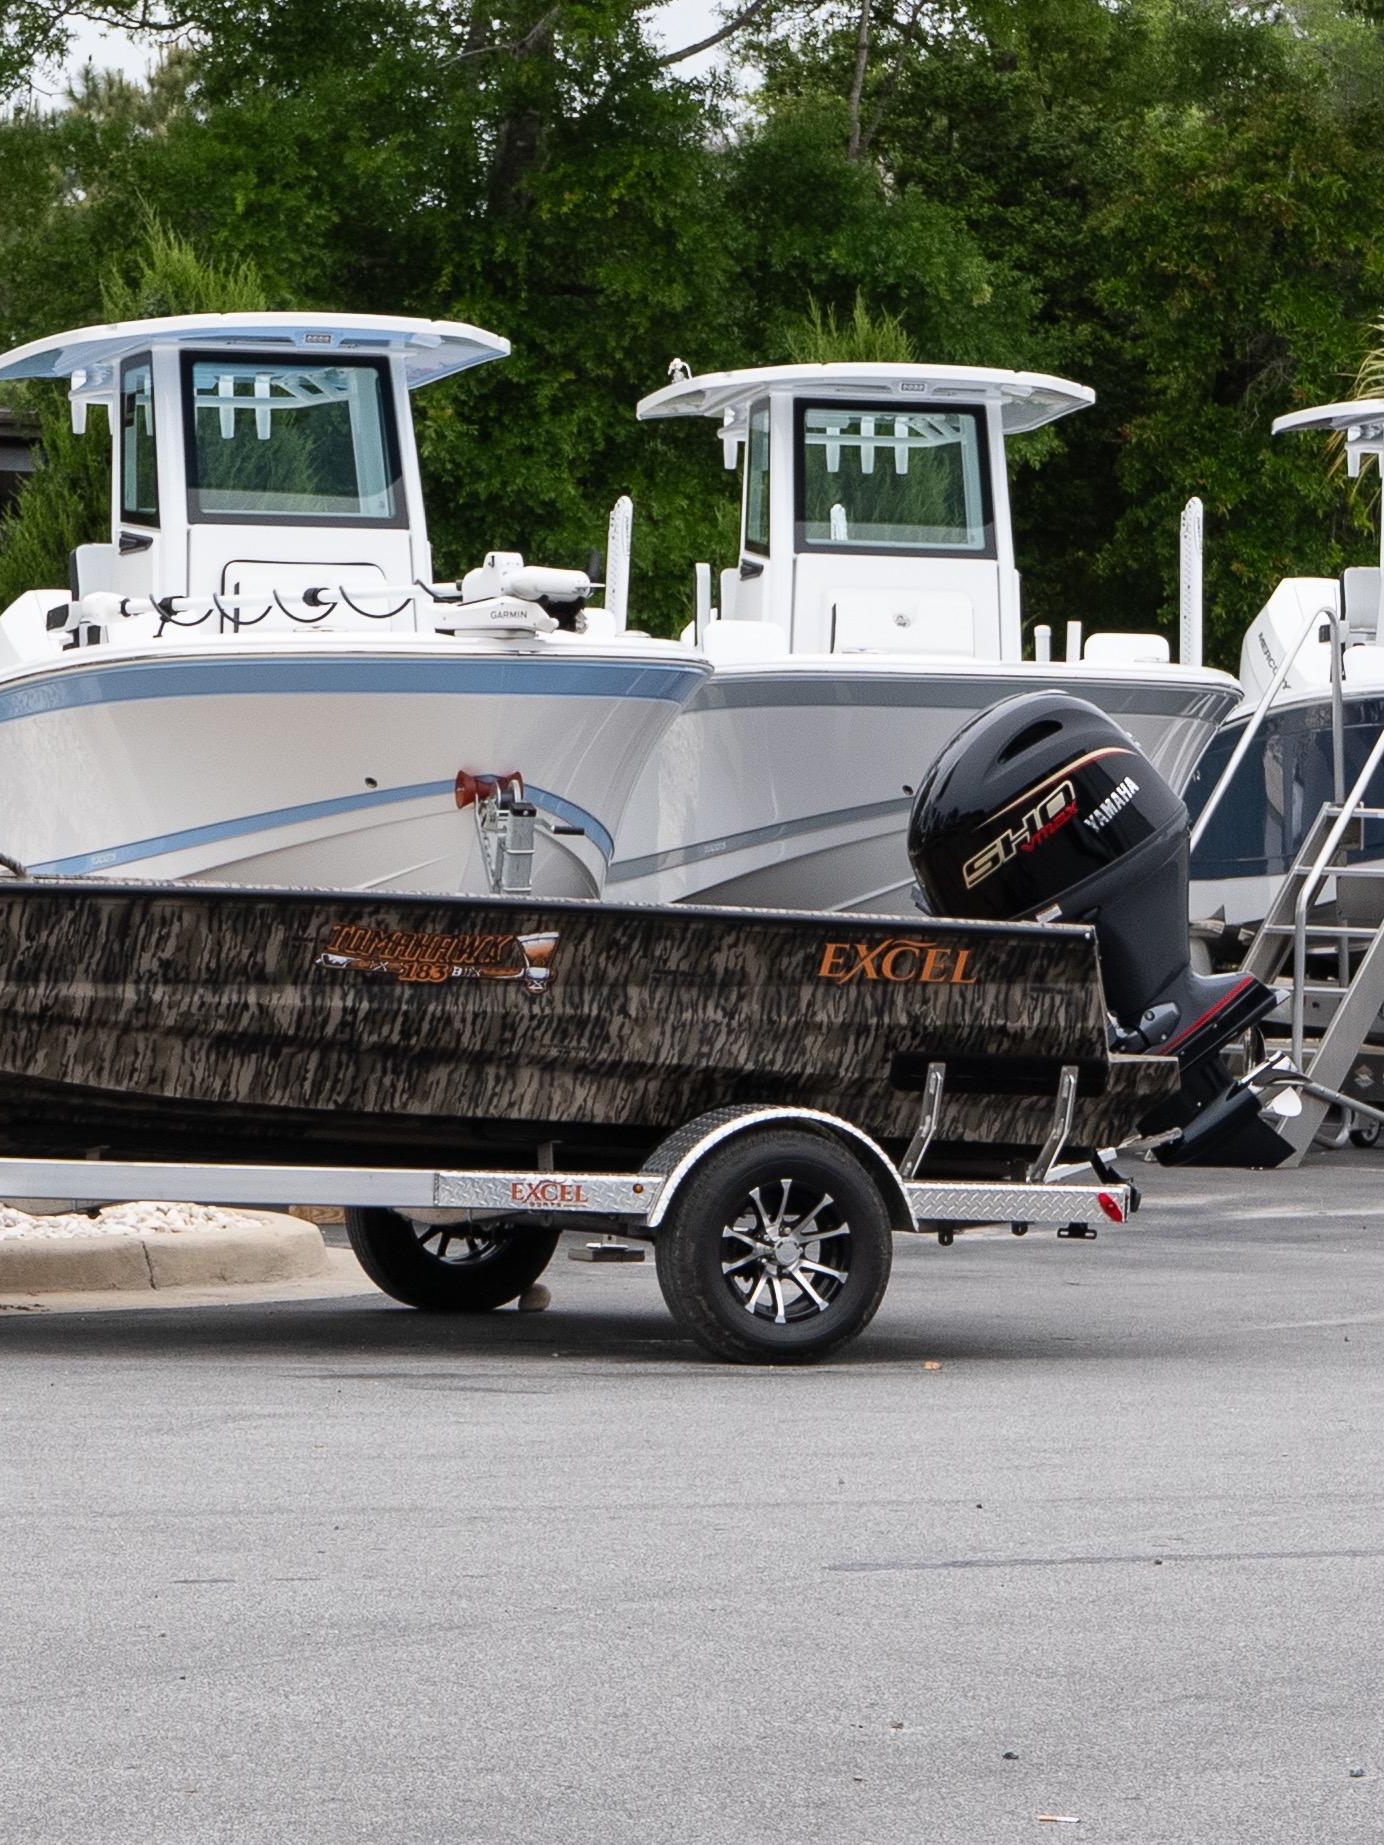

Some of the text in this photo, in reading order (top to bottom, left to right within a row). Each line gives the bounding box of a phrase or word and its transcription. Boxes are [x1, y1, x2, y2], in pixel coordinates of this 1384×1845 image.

[489, 610, 527, 619] GARMIN
[1258, 631, 1291, 690] MERCUY
[1083, 776, 1140, 833] YAMAHA
[963, 780, 1076, 889] SHO
[327, 923, 514, 964] TOMAHAWK
[818, 938, 977, 984] EXCEL
[400, 962, 448, 982] 183
[511, 1180, 588, 1203] EXCEL
